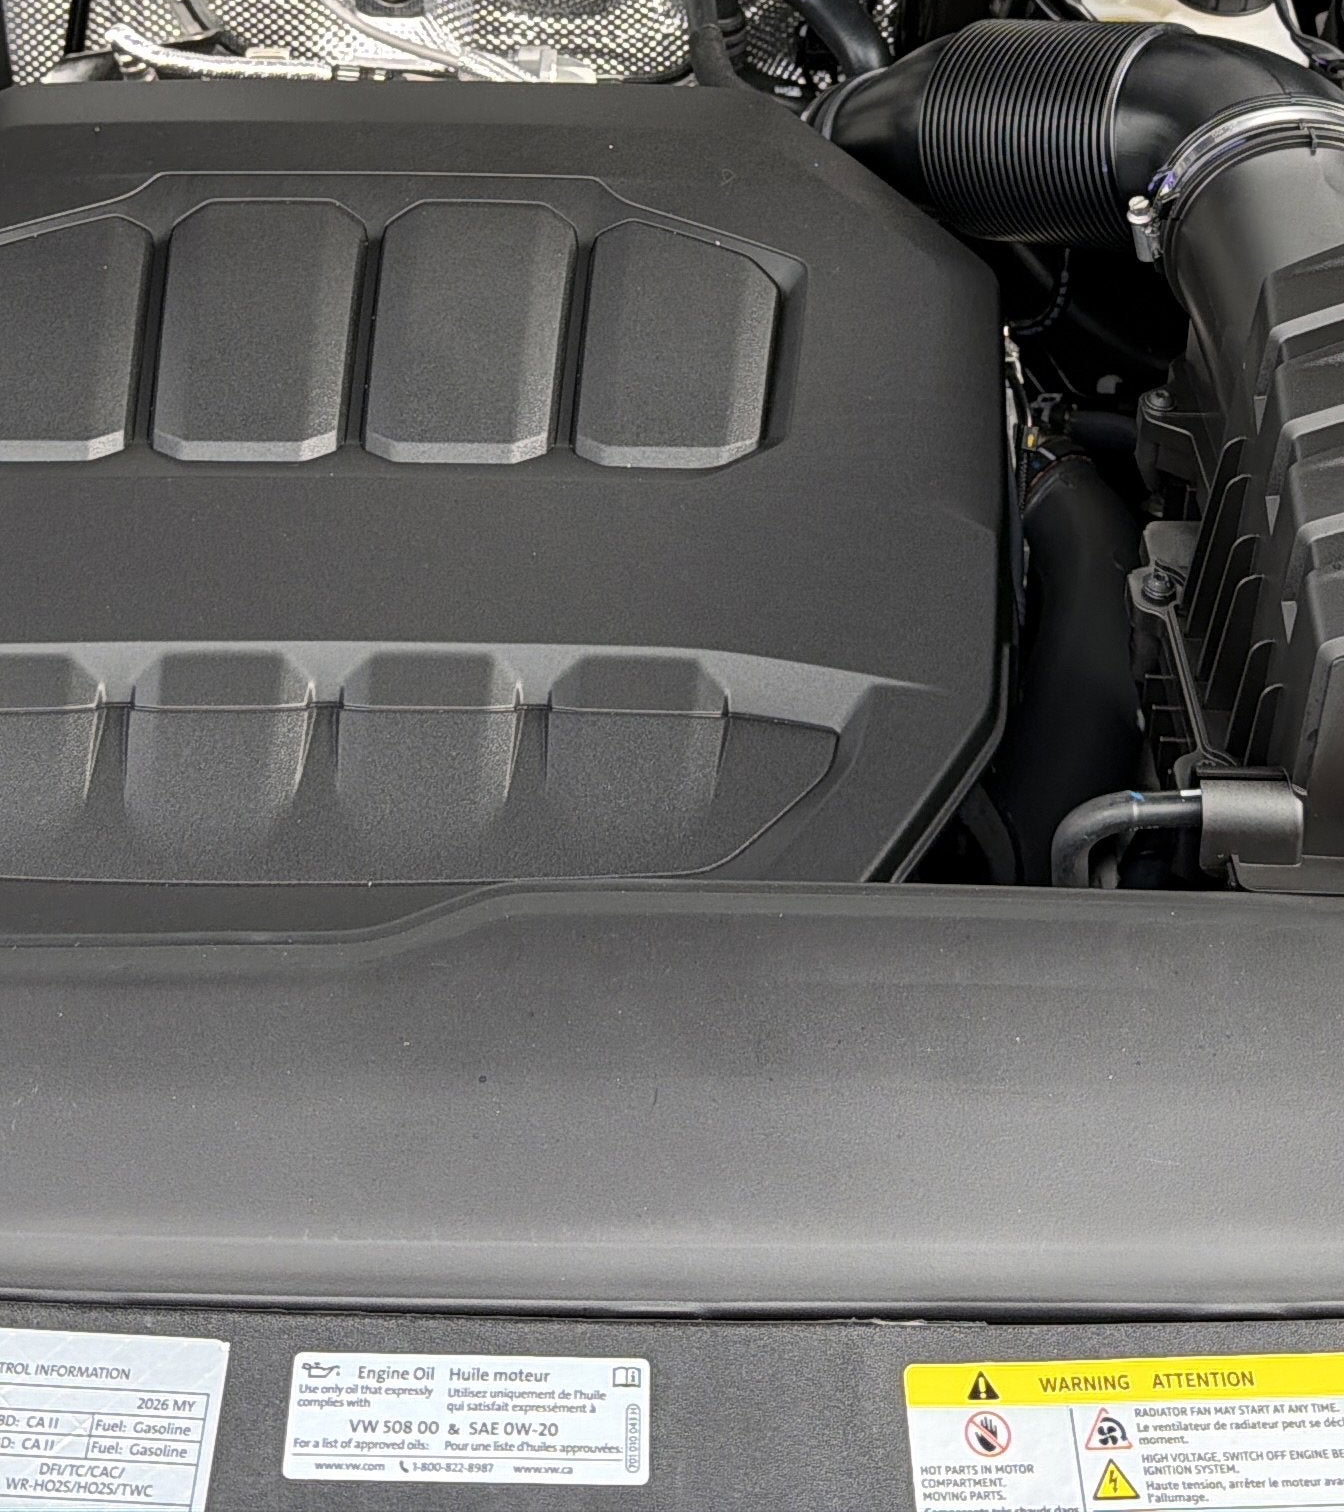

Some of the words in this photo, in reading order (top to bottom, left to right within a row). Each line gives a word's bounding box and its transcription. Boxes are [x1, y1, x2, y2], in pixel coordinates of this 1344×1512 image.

[34, 1362, 131, 1380] INFORMATION
[357, 1365, 410, 1384] Engine
[413, 1366, 436, 1381] Oil
[449, 1367, 489, 1382] Huile
[493, 1369, 551, 1383] moteur
[1038, 1374, 1130, 1393] WARNING
[1152, 1371, 1255, 1389] ATTENTION
[298, 1384, 320, 1394] Use
[321, 1384, 344, 1397] only
[345, 1384, 358, 1394] oil
[360, 1384, 382, 1395] that
[384, 1385, 433, 1399] expressly
[447, 1387, 488, 1399] Utilisez
[489, 1389, 556, 1402] uniquement
[558, 1389, 571, 1400] de
[574, 1389, 607, 1401] l'huile
[137, 1397, 169, 1411] 2026
[172, 1399, 196, 1412] MY
[297, 1398, 344, 1409] complies
[346, 1398, 371, 1408] with
[446, 1402, 464, 1414] qui
[466, 1401, 509, 1412] satisfait
[1134, 1406, 1188, 1418] RADIATOR
[1190, 1405, 1211, 1416] FAN
[1214, 1405, 1237, 1415] MAY
[1238, 1404, 1270, 1415] START
[1272, 1404, 1285, 1414] AT
[1288, 1403, 1309, 1413] ANY
[1310, 1402, 1340, 1413] TIME.
[26, 1415, 45, 1428] CA
[94, 1419, 127, 1432] Fuel:
[133, 1421, 192, 1436] Gasoline
[349, 1418, 379, 1434] VW
[383, 1420, 413, 1434] 508
[417, 1420, 440, 1435] 00
[447, 1423, 460, 1435] &
[468, 1422, 499, 1436] SAE
[503, 1422, 559, 1437] 0W-20
[1136, 1422, 1150, 1433] Le
[1152, 1420, 1211, 1432] ventilateur
[1213, 1420, 1227, 1431] de
[1229, 1418, 1278, 1430] radiateur
[1282, 1418, 1307, 1431] peut
[1309, 1418, 1321, 1427] se
[21, 1437, 41, 1450] CA
[292, 1437, 310, 1448] For
[312, 1440, 319, 1449] a
[322, 1438, 338, 1449] list
[340, 1437, 353, 1449] of
[353, 1439, 405, 1452] approved
[407, 1440, 429, 1451] oils:
[444, 1440, 469, 1452] Pour
[470, 1442, 491, 1452] une
[493, 1441, 515, 1452] liste
[1138, 1435, 1189, 1445] moment.
[90, 1441, 123, 1455] Fuel:
[129, 1443, 188, 1459] Gasoline
[1141, 1453, 1168, 1464] HIGH
[1222, 1450, 1264, 1462] SWITCH
[1265, 1450, 1287, 1460] OFF
[1289, 1448, 1329, 1460] ENGINE
[38, 1462, 126, 1479] DFI/TC/CAC/
[313, 1462, 385, 1472] www.vw.com
[412, 1461, 494, 1474] 1-800-822-8987
[920, 1465, 942, 1476] HOT
[945, 1464, 979, 1475] PARTS
[980, 1464, 992, 1475] IN
[994, 1464, 1035, 1475] MOTOR
[1143, 1465, 1193, 1476] IGNITION
[1194, 1463, 1240, 1475] SYSTEM.
[5, 1477, 154, 1498] WR-HO2S/HO2S/TWC
[921, 1478, 1007, 1489] COMPARTMENT.
[1145, 1480, 1180, 1491] Haute
[1182, 1477, 1226, 1491] tension,
[1228, 1476, 1265, 1489] arrêter
[1268, 1477, 1279, 1488] le
[1282, 1478, 1322, 1487] moteur
[922, 1491, 967, 1502] MOVING
[969, 1490, 1006, 1501] PARTS.
